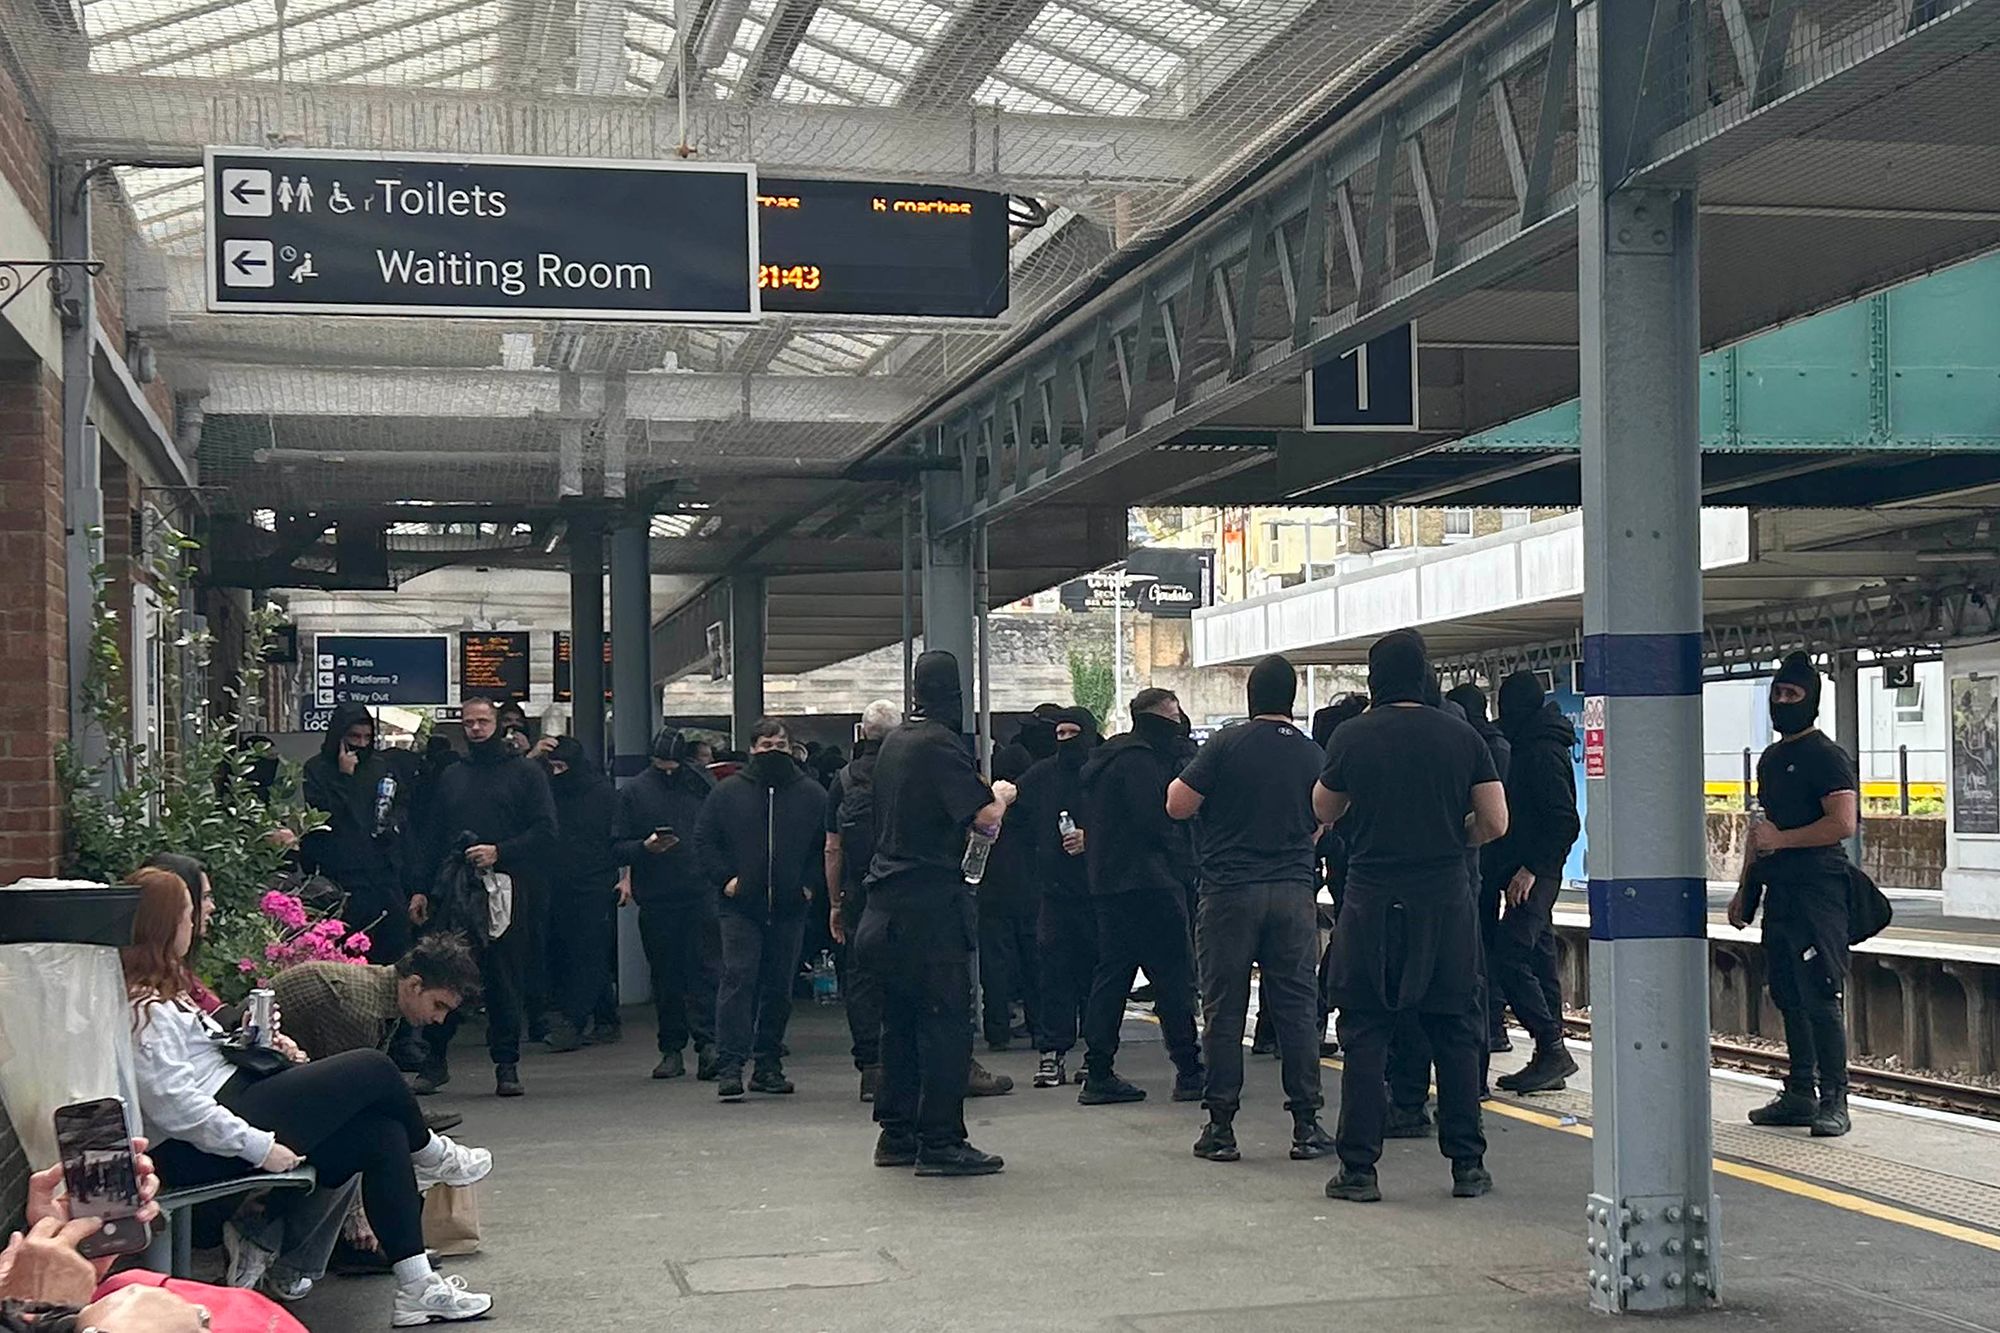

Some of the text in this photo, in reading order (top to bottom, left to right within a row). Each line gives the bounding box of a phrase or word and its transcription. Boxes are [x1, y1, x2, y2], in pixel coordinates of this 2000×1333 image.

[375, 178, 507, 217] Toilets
[375, 249, 651, 296] Waiting Room
[1340, 343, 1369, 410] 1
[350, 657, 374, 667] Taxis
[350, 674, 399, 685] Platform 2
[350, 692, 389, 703] Way Out
